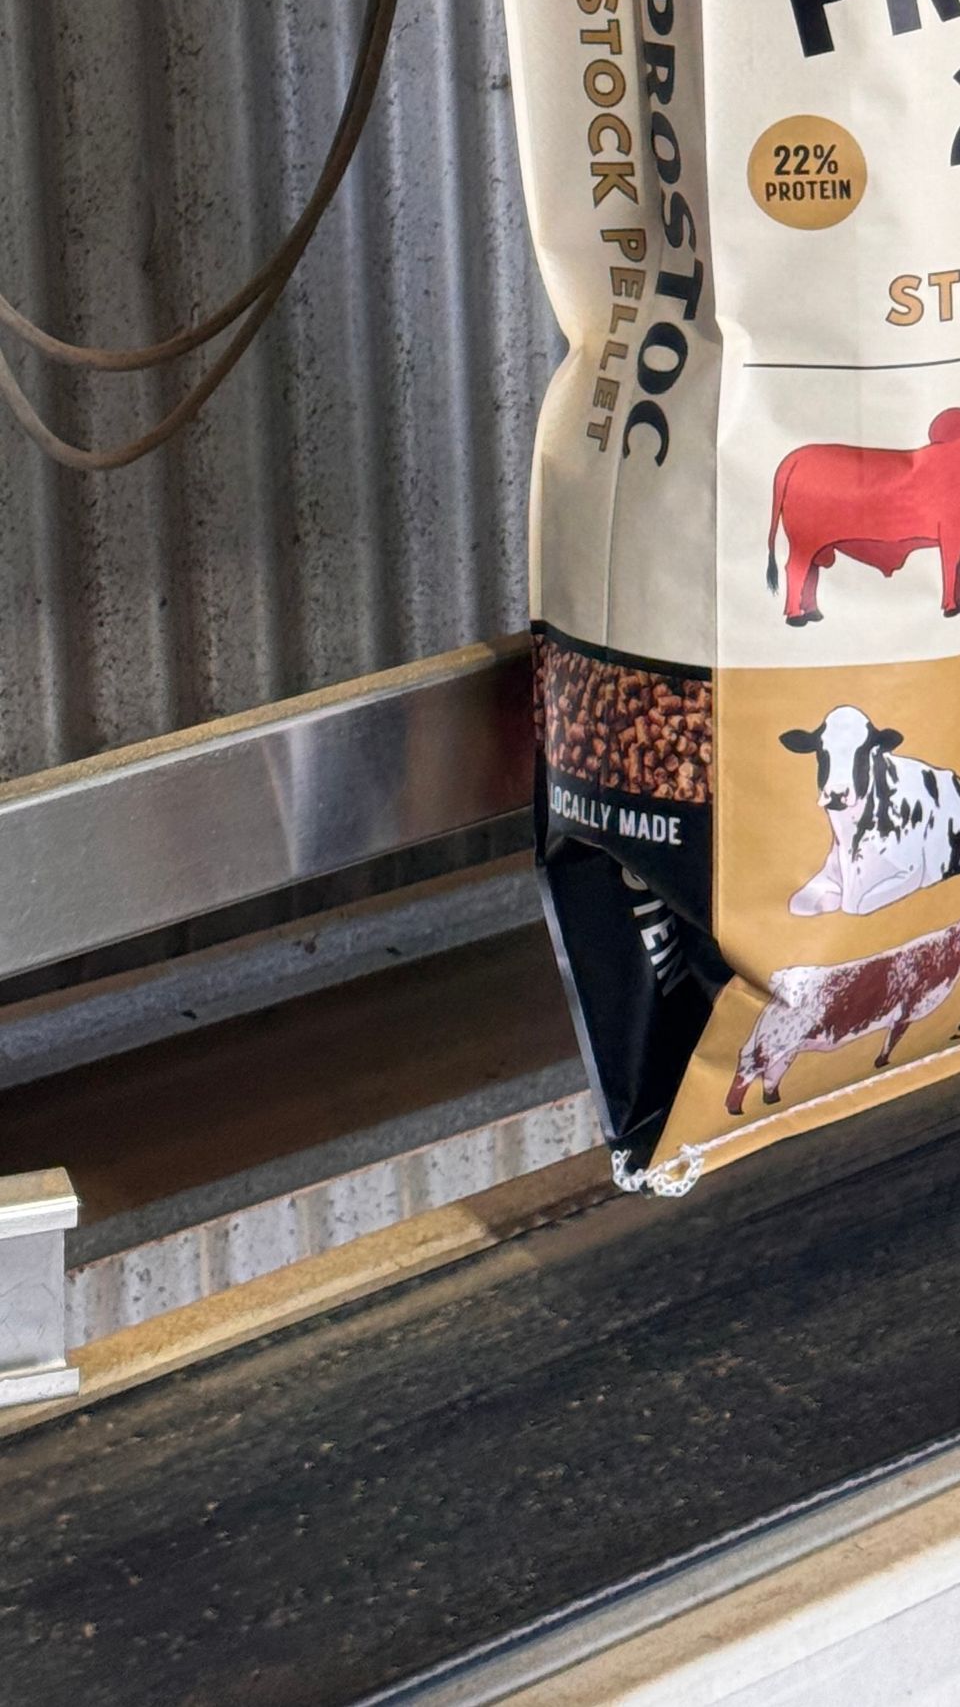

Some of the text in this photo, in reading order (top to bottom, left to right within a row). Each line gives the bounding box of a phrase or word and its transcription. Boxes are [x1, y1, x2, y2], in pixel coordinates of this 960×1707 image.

[774, 144, 838, 175] 22%
[765, 179, 851, 202] PROTEIN
[585, 228, 647, 453] PELLET
[550, 782, 682, 845] LOCALLY MADE
